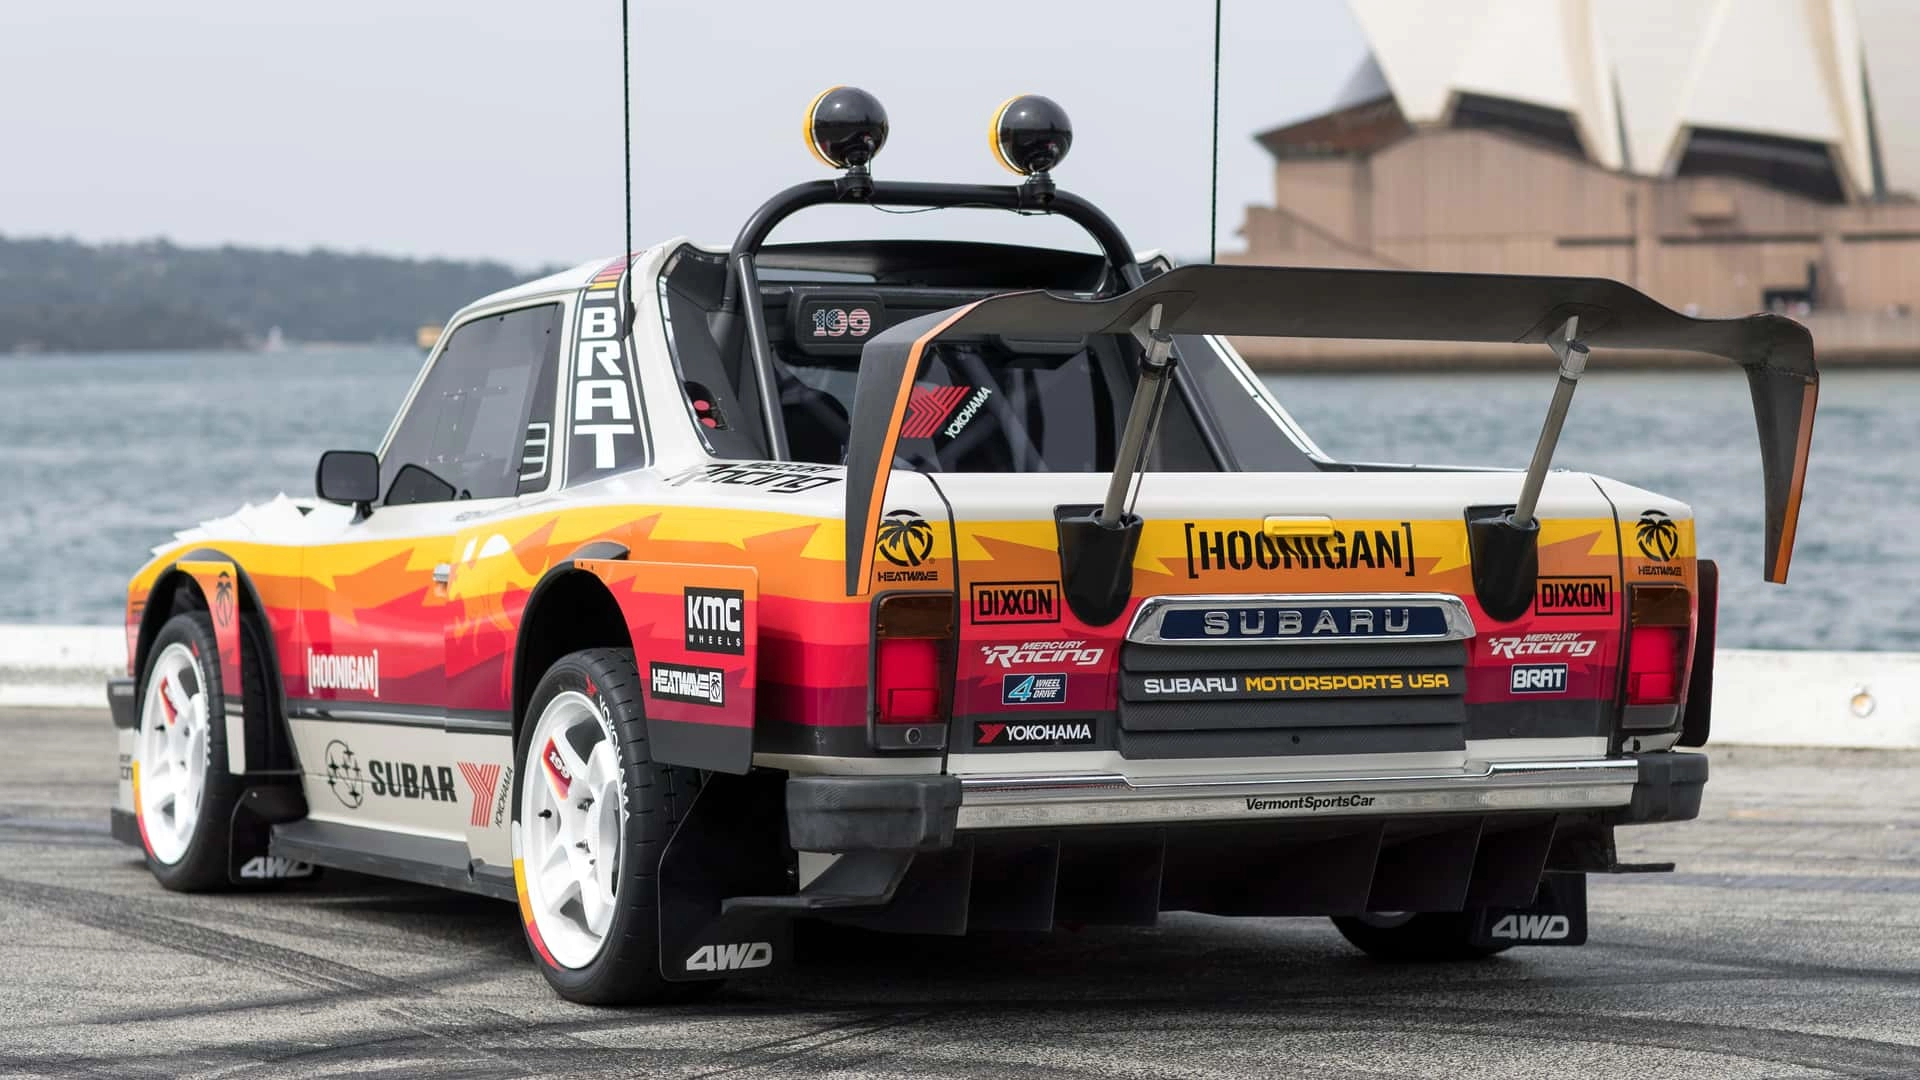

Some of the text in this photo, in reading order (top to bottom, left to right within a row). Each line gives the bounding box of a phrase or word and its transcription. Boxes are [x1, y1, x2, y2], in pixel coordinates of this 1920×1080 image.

[812, 308, 872, 337] 199
[574, 307, 635, 469] BRAT
[944, 386, 992, 439] YOKOHAMA
[878, 571, 939, 582] HEATWAVE
[1637, 566, 1683, 577] HEATWAVE
[978, 588, 1053, 616] DIXXON
[1541, 583, 1606, 608] DIXXON
[687, 595, 741, 632] KMC
[1203, 608, 1410, 635] SUBARU
[688, 634, 741, 647] WHEELS
[1020, 640, 1087, 651] MERCURY
[1488, 637, 1597, 659] Racing
[1523, 632, 1583, 642] MERCURY
[981, 645, 1105, 668] Racing
[652, 667, 710, 698] HEATWAVE
[1008, 675, 1061, 701] 4 WHEEL
[1143, 673, 1449, 694] SUBARU MOTORSPORTS USA
[1512, 668, 1566, 689] BRAT
[1032, 689, 1058, 699] DRIVE
[1005, 723, 1092, 741] YOKOHAMA
[548, 751, 571, 778] 199
[368, 760, 458, 803] SUBAR
[1245, 794, 1376, 811] VermontSportsCar
[240, 856, 314, 878] 4WD
[1491, 914, 1570, 940] 4WD
[686, 941, 773, 972] 4WD
